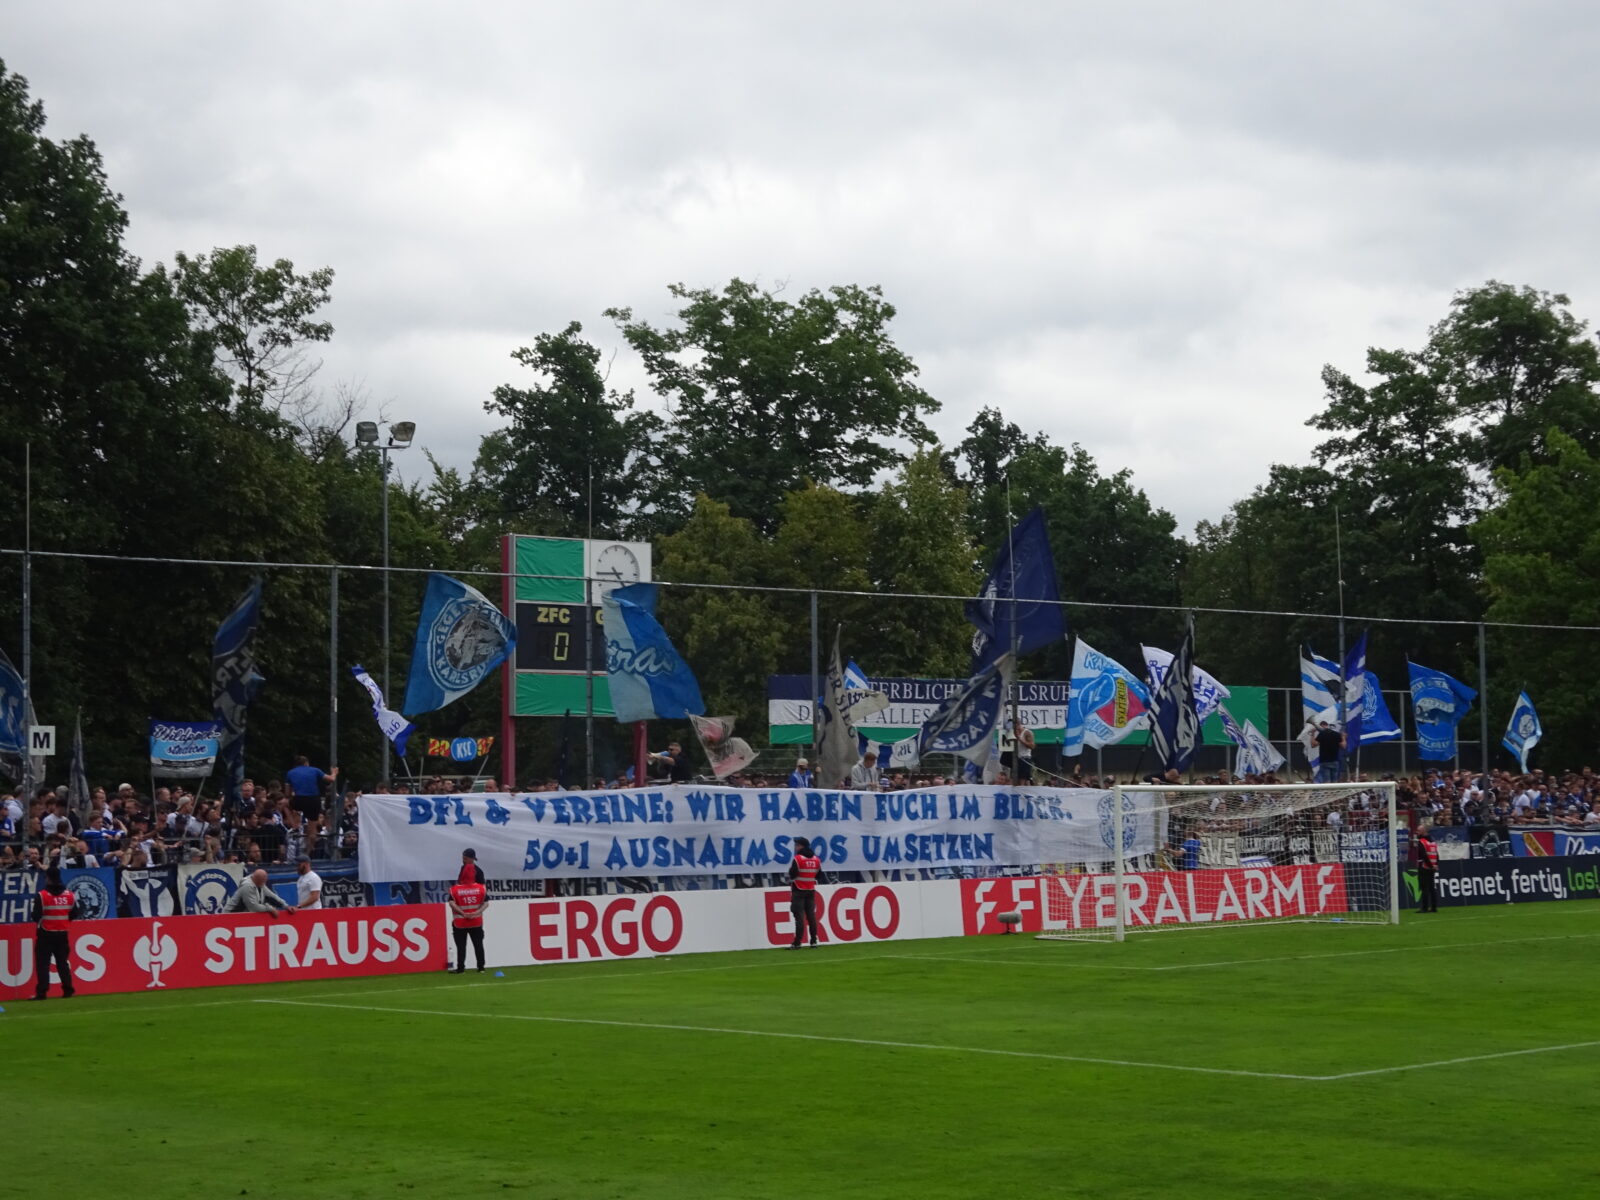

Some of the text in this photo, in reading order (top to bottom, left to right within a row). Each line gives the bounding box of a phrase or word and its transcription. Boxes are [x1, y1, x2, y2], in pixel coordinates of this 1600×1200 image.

[537, 606, 571, 624] ZFC
[553, 632, 570, 661] 0
[876, 708, 930, 724] ALLES
[33, 732, 50, 748] M
[456, 741, 472, 758] KSC
[408, 796, 473, 826] DFL
[485, 797, 511, 826] &
[521, 792, 674, 825] VEREINE:
[685, 790, 746, 822] WIR
[758, 792, 863, 823] HABEN
[874, 793, 939, 822] EUCH
[949, 793, 982, 821] IM
[523, 833, 994, 872] 50+1 AUSNAHMSOS UMSETZEN
[3, 872, 39, 895] EN
[324, 883, 361, 895] ULTRAS
[1511, 867, 1568, 899] fertig,
[1567, 865, 1600, 892] los!
[1011, 867, 1306, 932] FLYERALARM
[528, 894, 683, 961] ERGO
[204, 917, 430, 974] STRAUSS
